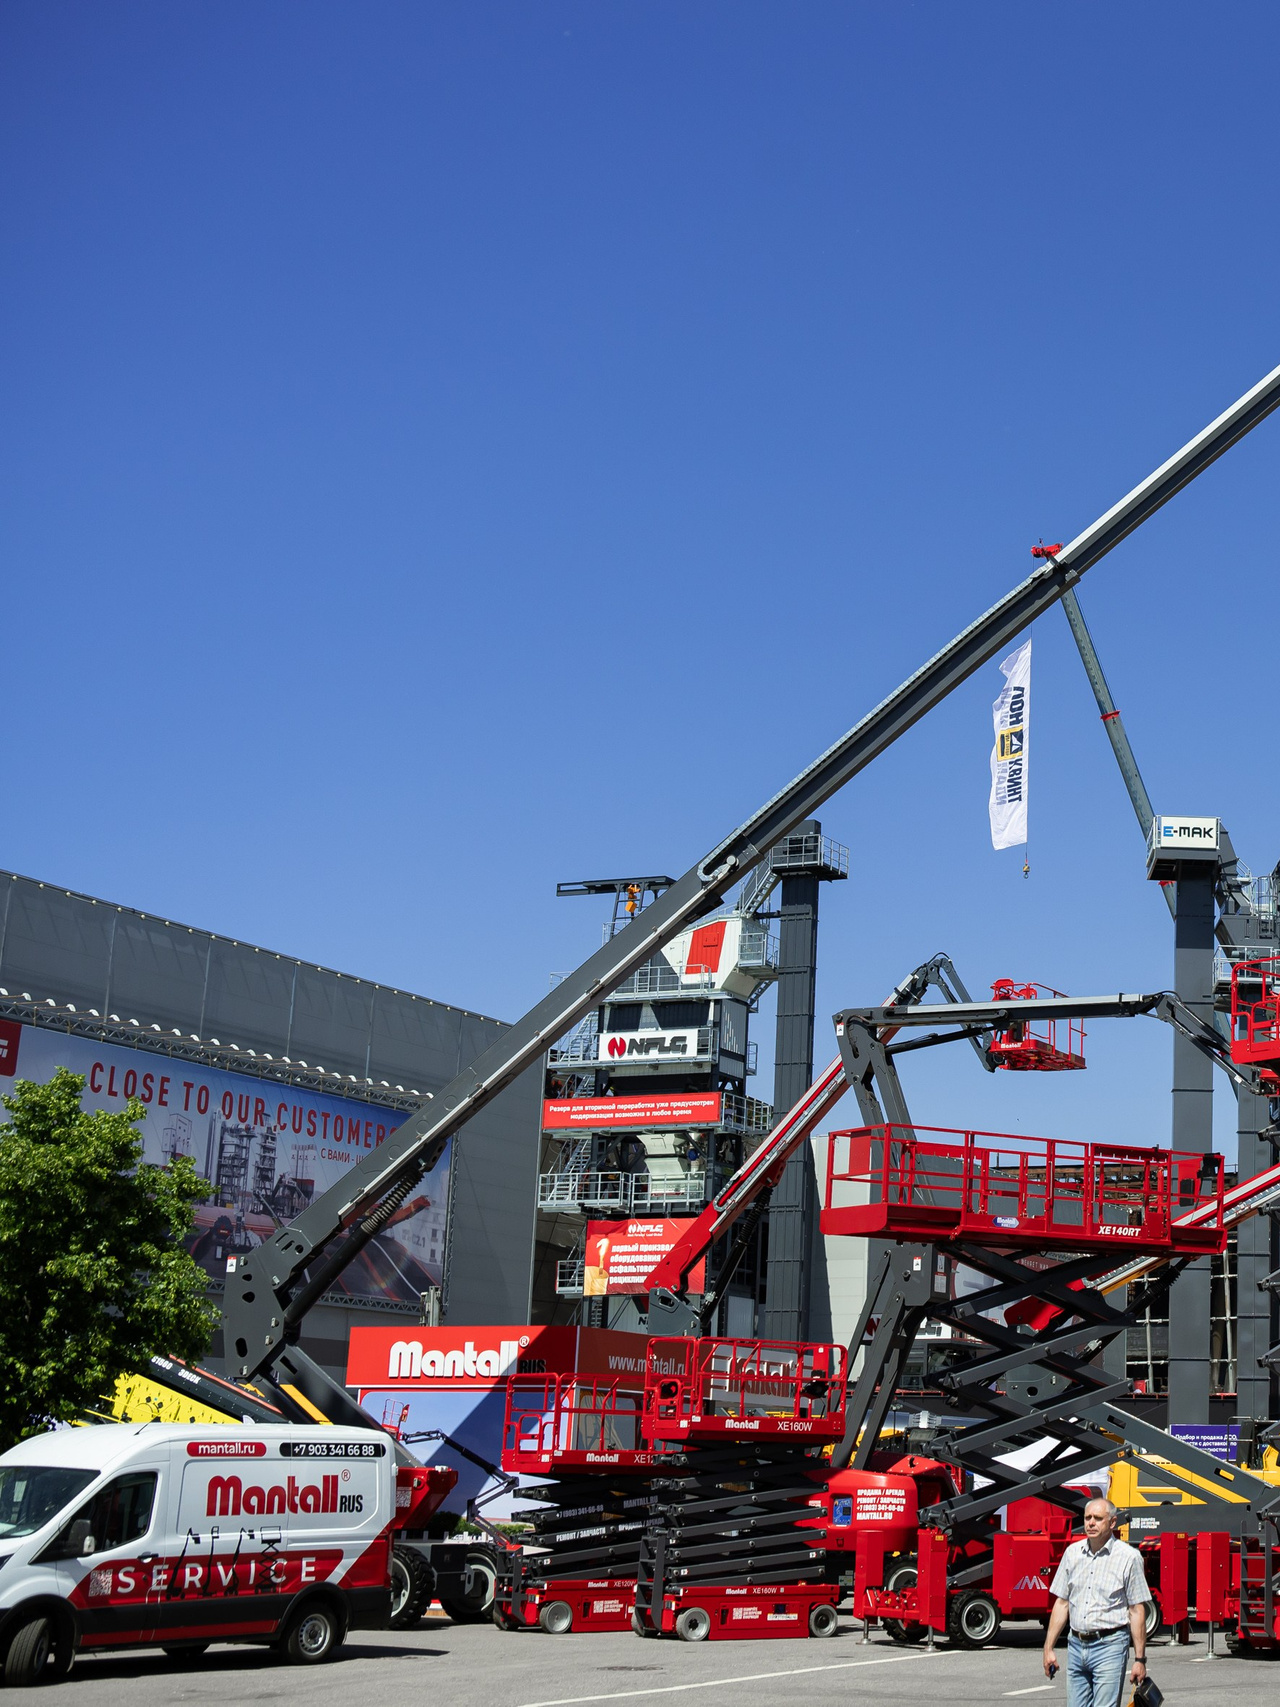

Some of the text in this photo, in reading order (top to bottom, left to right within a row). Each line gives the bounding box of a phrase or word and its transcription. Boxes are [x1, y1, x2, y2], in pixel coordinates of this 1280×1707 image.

[1163, 825, 1214, 839] E-MAK
[627, 1035, 688, 1055] NFLG
[90, 1061, 171, 1107] CLOSE
[183, 1080, 210, 1115] TO
[221, 1091, 266, 1128] OUR
[549, 1105, 570, 1113] Резерв
[584, 1103, 616, 1111] вторичной
[617, 1101, 655, 1111] переработки
[656, 1101, 669, 1109] уже
[670, 1099, 714, 1109] предусмотрен
[570, 1112, 614, 1120] модернизация
[614, 1111, 645, 1119] возможна
[651, 1108, 672, 1117] любое
[672, 1109, 692, 1117] время
[327, 1149, 351, 1164] ВАМИ
[1098, 1226, 1141, 1237] XE140RT
[388, 1341, 519, 1378] Mantall
[151, 1354, 201, 1385] S1500 3DECK
[725, 1419, 813, 1432] Mantall XE160W
[198, 1443, 375, 1456] mantall.ru +7 903 341 66 88
[586, 1452, 619, 1462] Mantall
[206, 1474, 364, 1517] Mantall RUS
[857, 1497, 876, 1505] РЕМОНТ
[623, 1496, 658, 1509] MANTALL.RU
[856, 1512, 893, 1520] MANTALL.RU
[556, 1532, 576, 1542] РЕМОНТ
[117, 1556, 316, 1594] SERVICE
[752, 1587, 777, 1595] XE160W
